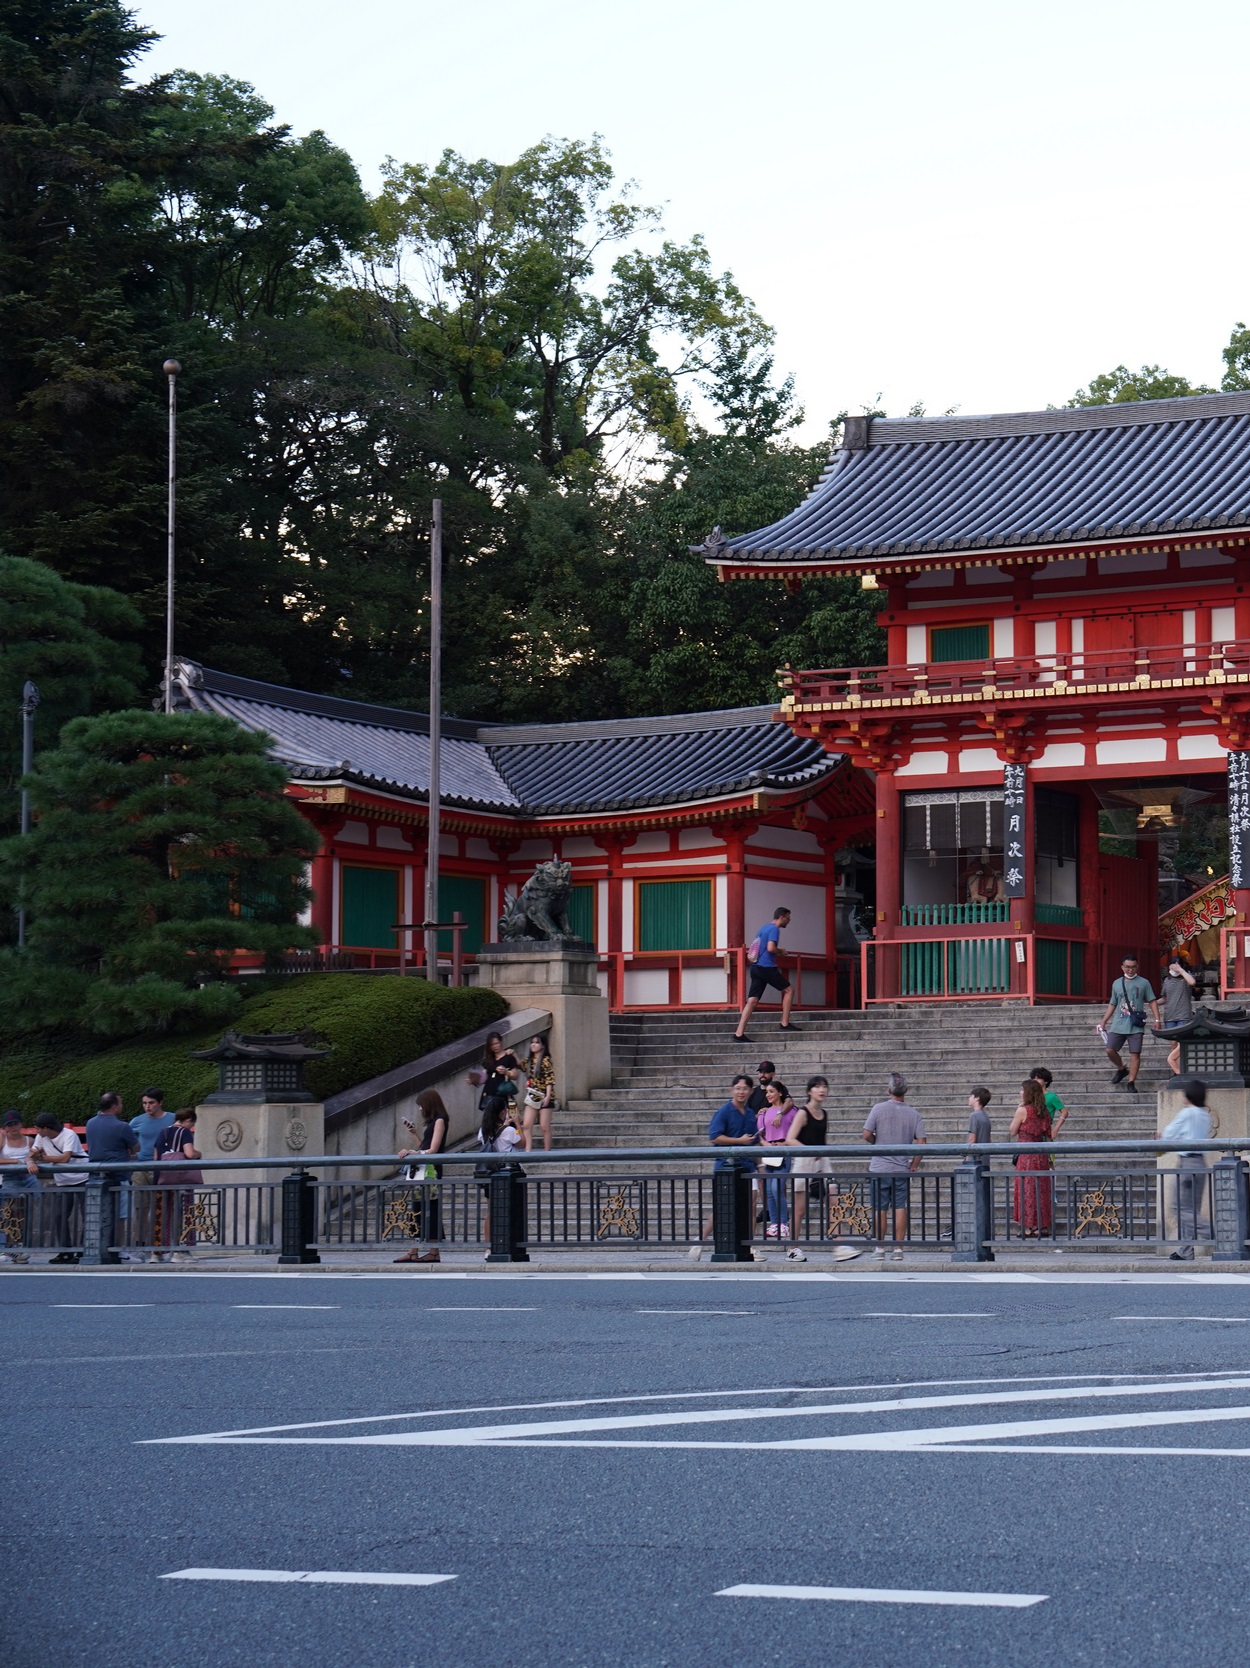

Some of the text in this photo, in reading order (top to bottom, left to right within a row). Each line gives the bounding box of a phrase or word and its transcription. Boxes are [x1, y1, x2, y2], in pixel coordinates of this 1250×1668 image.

[1004, 765, 1016, 808] 午前十時
[1014, 766, 1025, 804] 九月一日
[1228, 752, 1240, 791] 午前十時
[1239, 752, 1250, 790] 九月十五日
[1005, 815, 1023, 887] 月次祭
